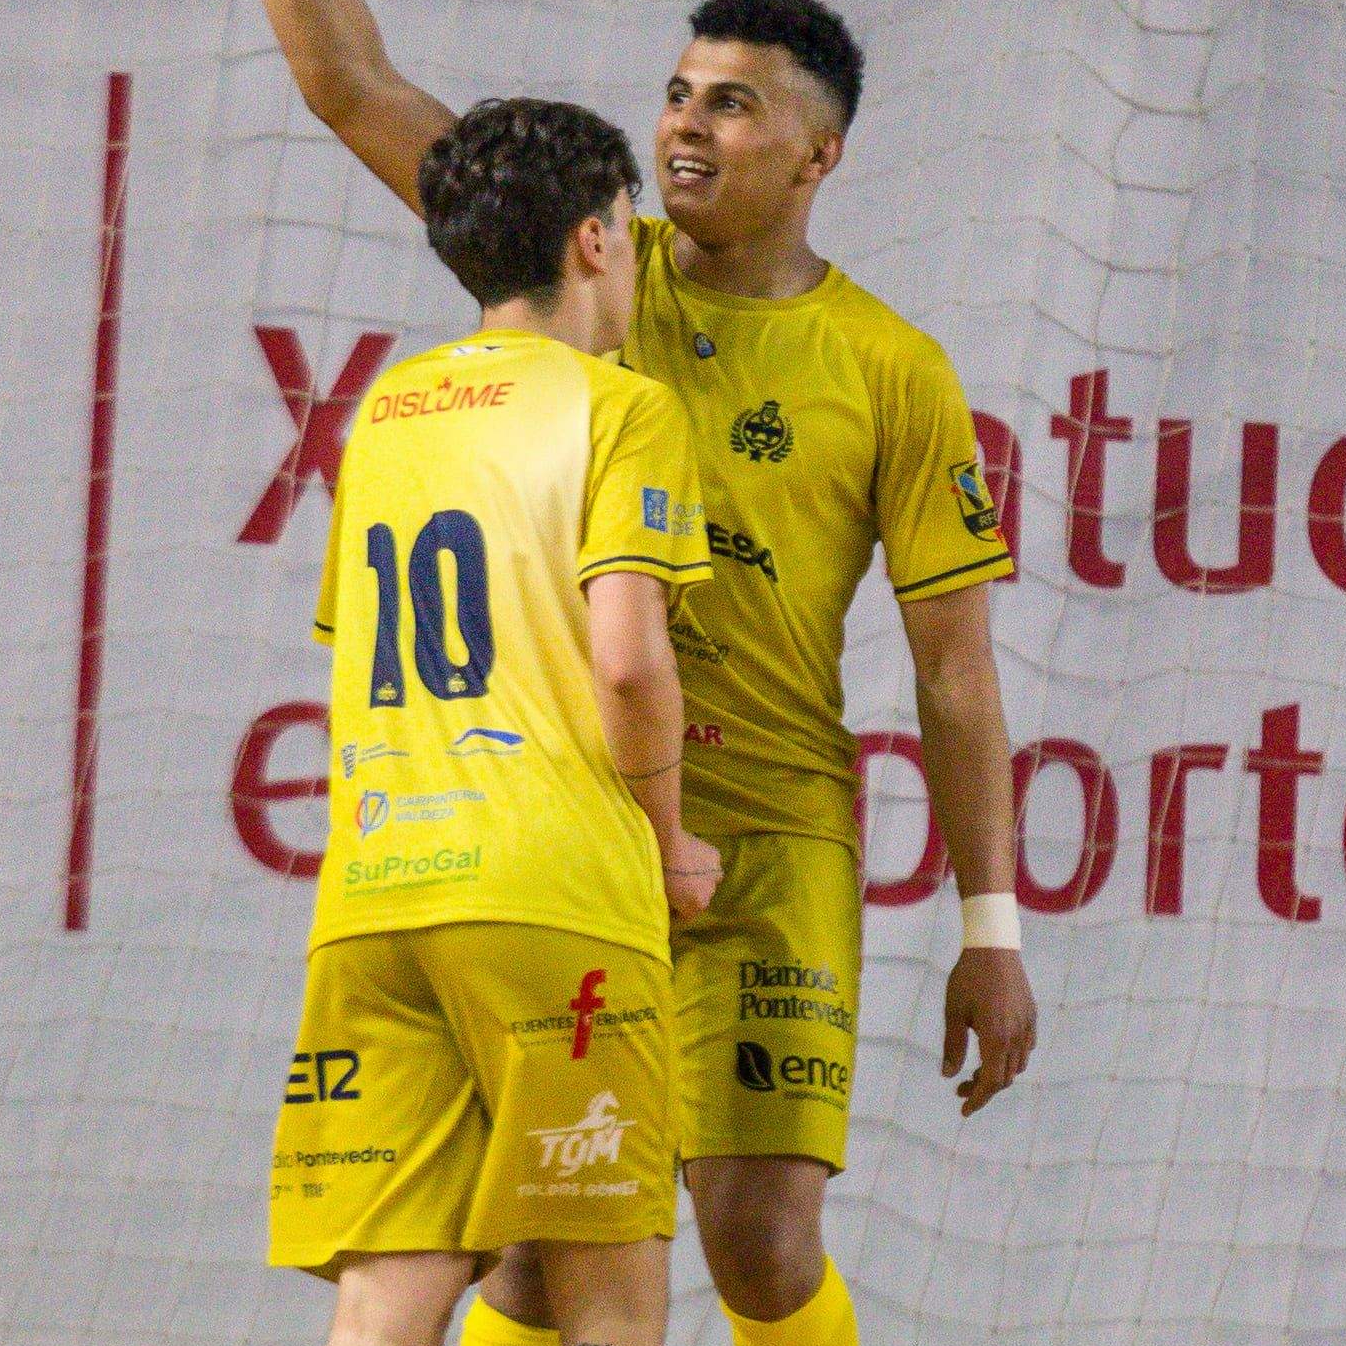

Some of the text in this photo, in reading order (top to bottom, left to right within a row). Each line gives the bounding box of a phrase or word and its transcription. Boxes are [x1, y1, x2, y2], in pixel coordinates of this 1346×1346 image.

[367, 509, 496, 708] 10
[344, 846, 483, 885] SuProGal
[780, 1055, 848, 1095] ence
[296, 1146, 397, 1168] Pontevedra
